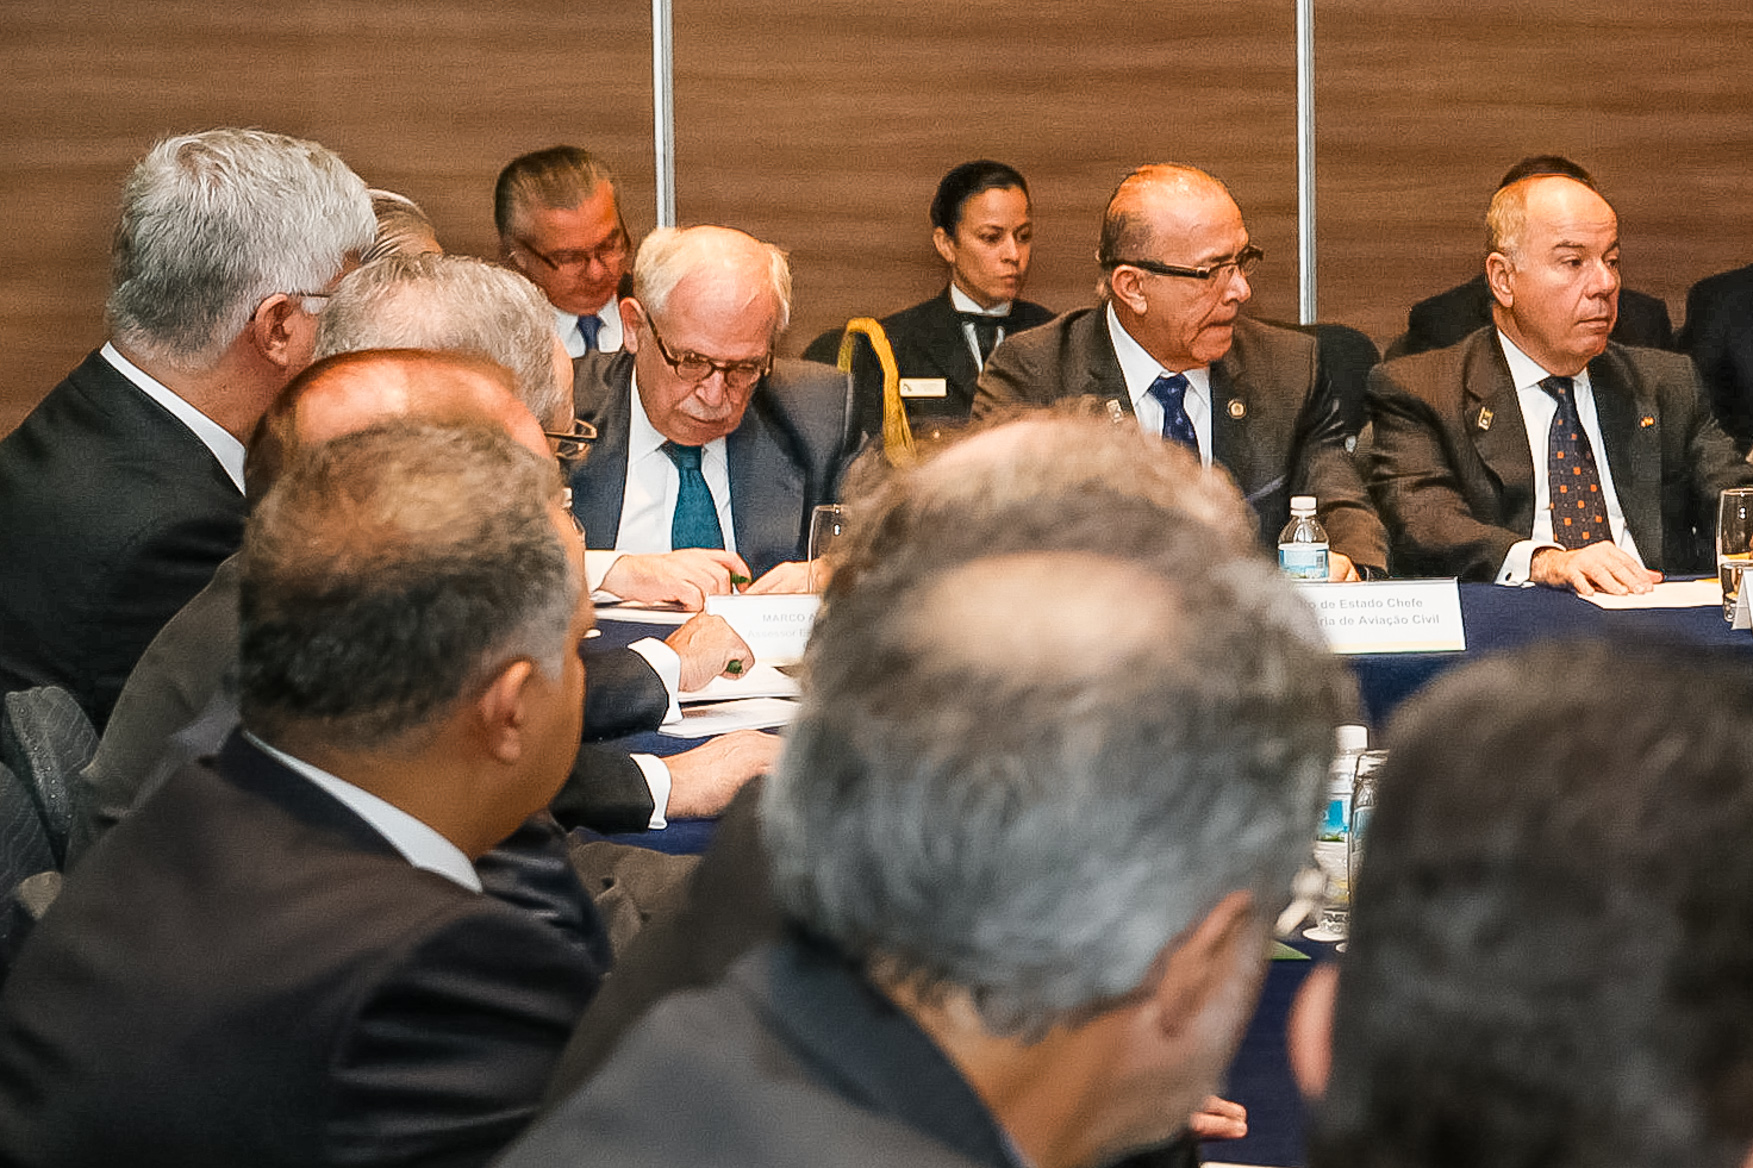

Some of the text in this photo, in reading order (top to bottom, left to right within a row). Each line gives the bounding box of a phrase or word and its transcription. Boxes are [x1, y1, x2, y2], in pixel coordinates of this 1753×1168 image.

[1320, 599, 1336, 609] de
[1340, 598, 1384, 609] Estado
[1387, 597, 1423, 608] Chefe
[762, 613, 805, 622] MARCO
[1340, 616, 1354, 626] de
[1358, 614, 1409, 626] Aviação
[1412, 613, 1440, 625] Civil
